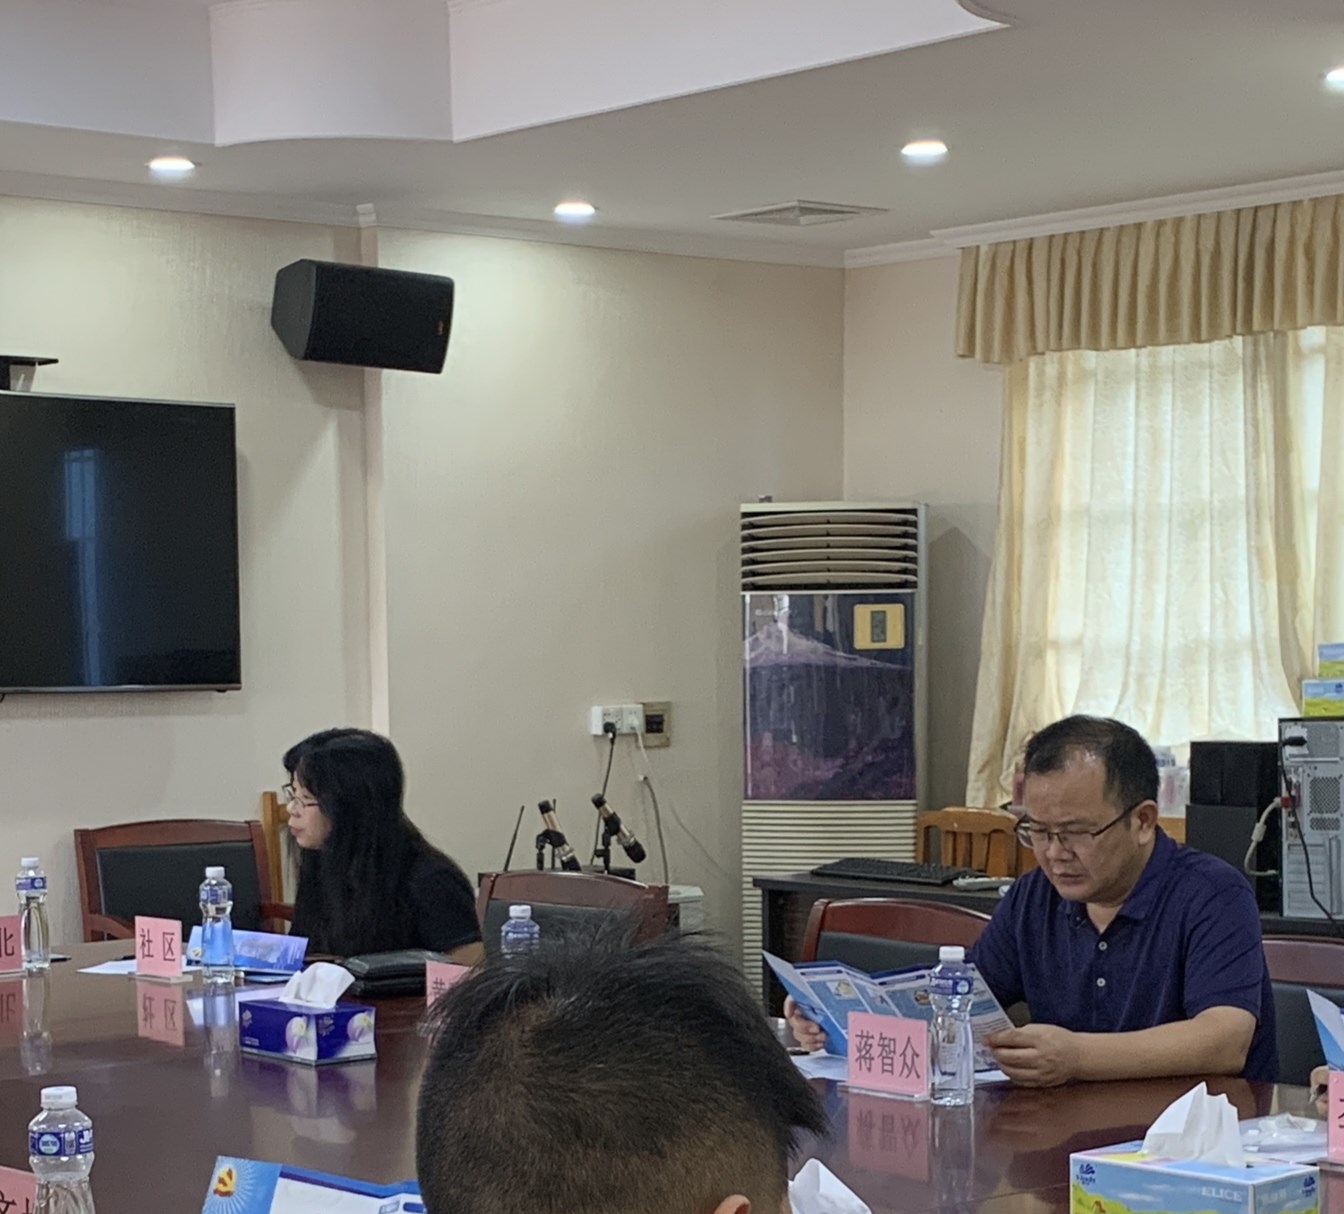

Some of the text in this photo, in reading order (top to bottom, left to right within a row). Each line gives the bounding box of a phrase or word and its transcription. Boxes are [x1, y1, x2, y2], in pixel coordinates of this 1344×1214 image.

[140, 928, 177, 962] 社区
[854, 1029, 921, 1080] 蒋智众
